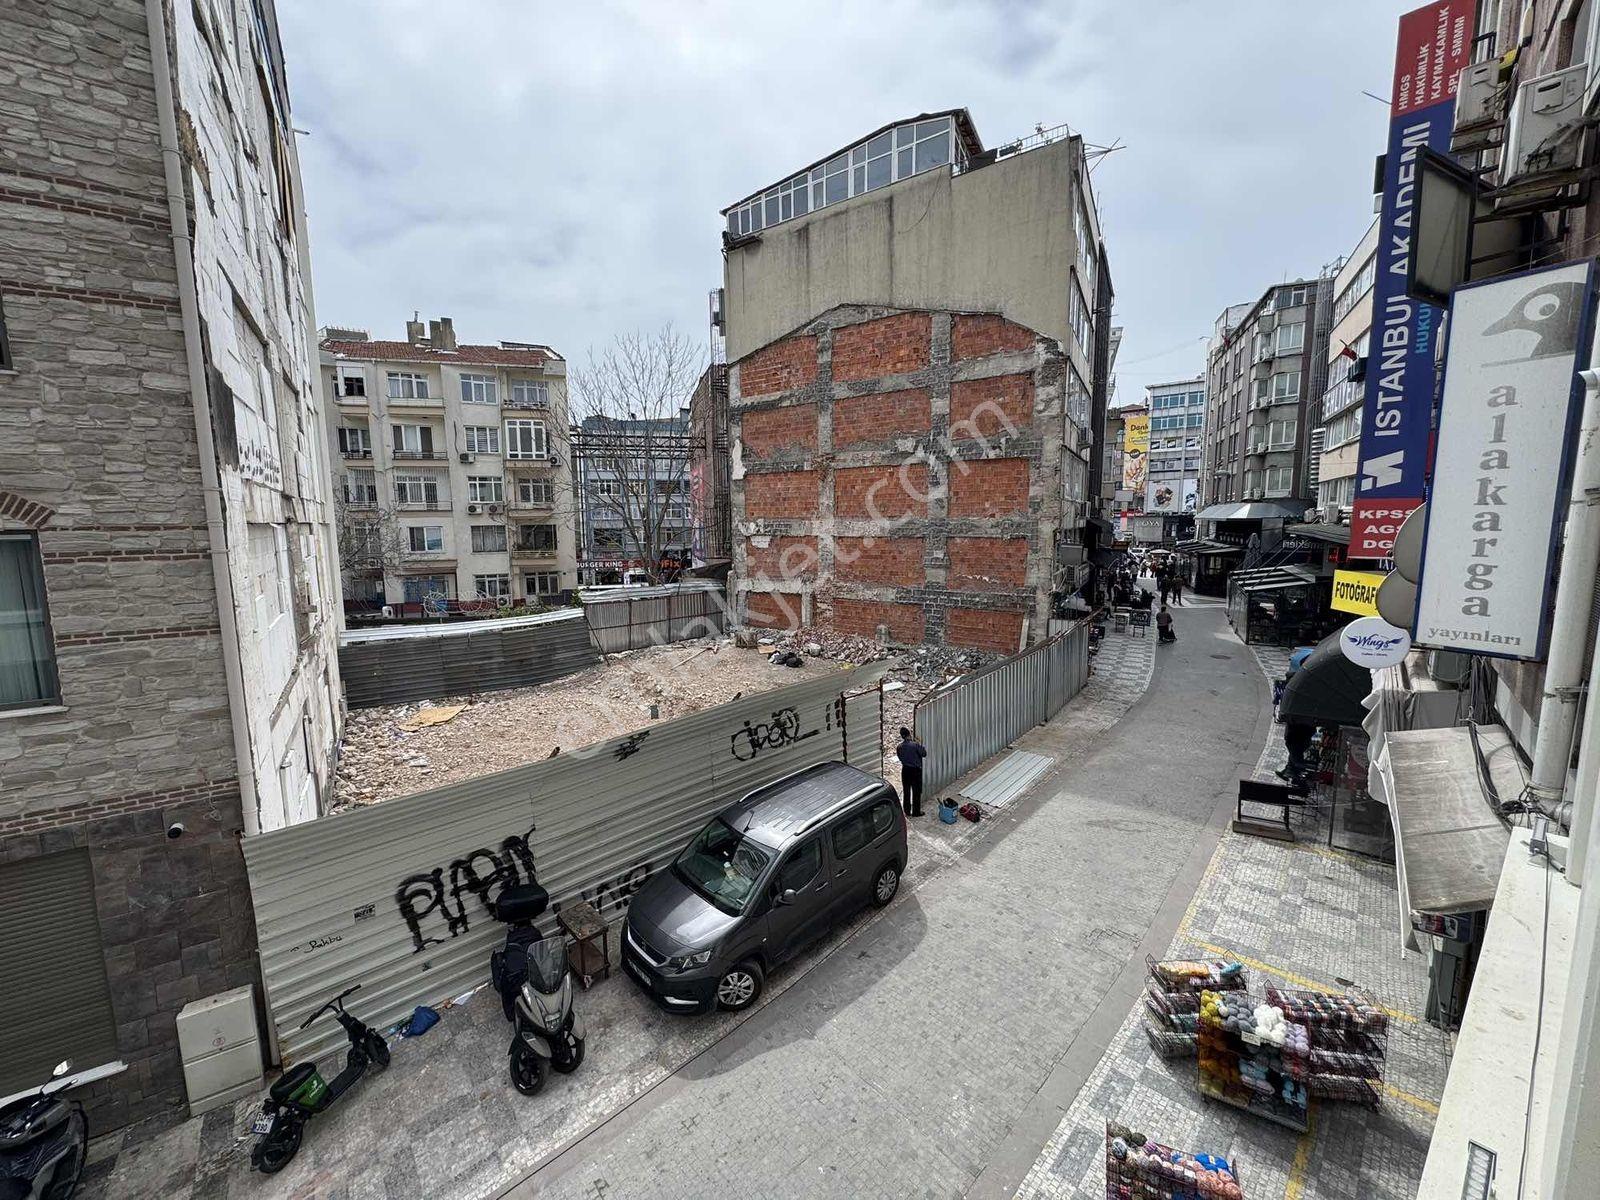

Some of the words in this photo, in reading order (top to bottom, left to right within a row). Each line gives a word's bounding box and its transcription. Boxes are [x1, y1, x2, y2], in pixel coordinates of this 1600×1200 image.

[1451, 16, 1465, 57] SMMM
[1430, 5, 1450, 100] KAYMAKAMLIK
[1398, 74, 1411, 110] HMGS
[1447, 68, 1460, 94] SPL
[1460, 384, 1519, 618] alakarga
[605, 560, 623, 568] KING
[1335, 580, 1379, 606] FOTOĞRAF
[1356, 634, 1392, 650] Wings
[1427, 626, 1522, 646] yayınları
